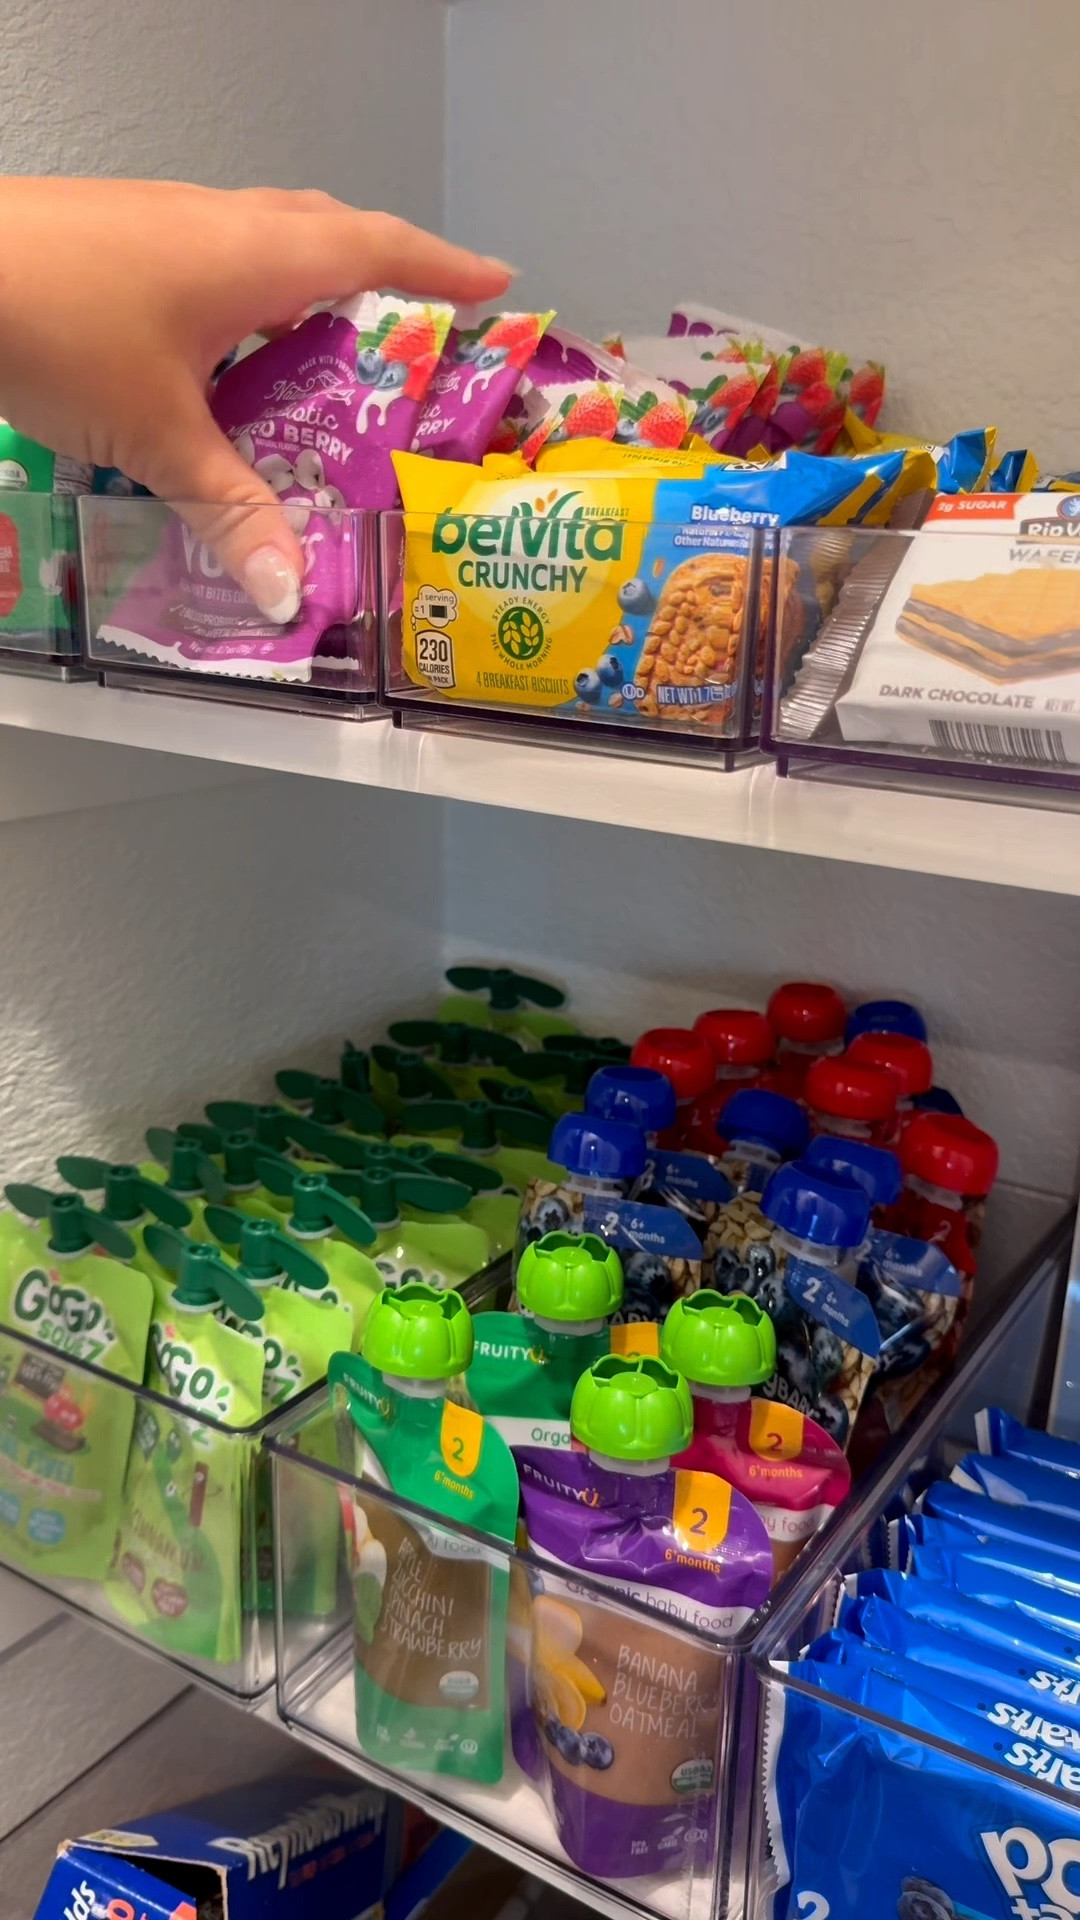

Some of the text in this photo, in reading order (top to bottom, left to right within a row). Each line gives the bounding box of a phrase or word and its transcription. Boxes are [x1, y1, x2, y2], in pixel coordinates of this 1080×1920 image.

[284, 423, 354, 465] BERRY
[691, 505, 779, 526] Blueberry
[937, 499, 1007, 513] 2g SUGAR
[458, 560, 587, 593] CRUNCHY
[425, 594, 455, 604] serving
[492, 596, 551, 624] STEADY ENERGY
[419, 638, 448, 662] 230
[490, 633, 552, 670] THE WHOLE MORNING
[419, 662, 450, 674] CALORIES
[476, 671, 570, 695] 4 BREAKFAST BISCUITS
[657, 686, 675, 703] NET
[879, 684, 1035, 710] DARK CHOCOLATE
[802, 1277, 822, 1304] 2
[531, 1428, 571, 1446] Orga
[767, 1433, 782, 1450] 2
[452, 1438, 465, 1462] 2
[690, 1508, 708, 1535] 2
[381, 1605, 481, 1659] STRAWBERRY
[694, 1612, 733, 1630] food
[617, 1644, 697, 1692] BANANA
[610, 1703, 699, 1738] OATMEAL
